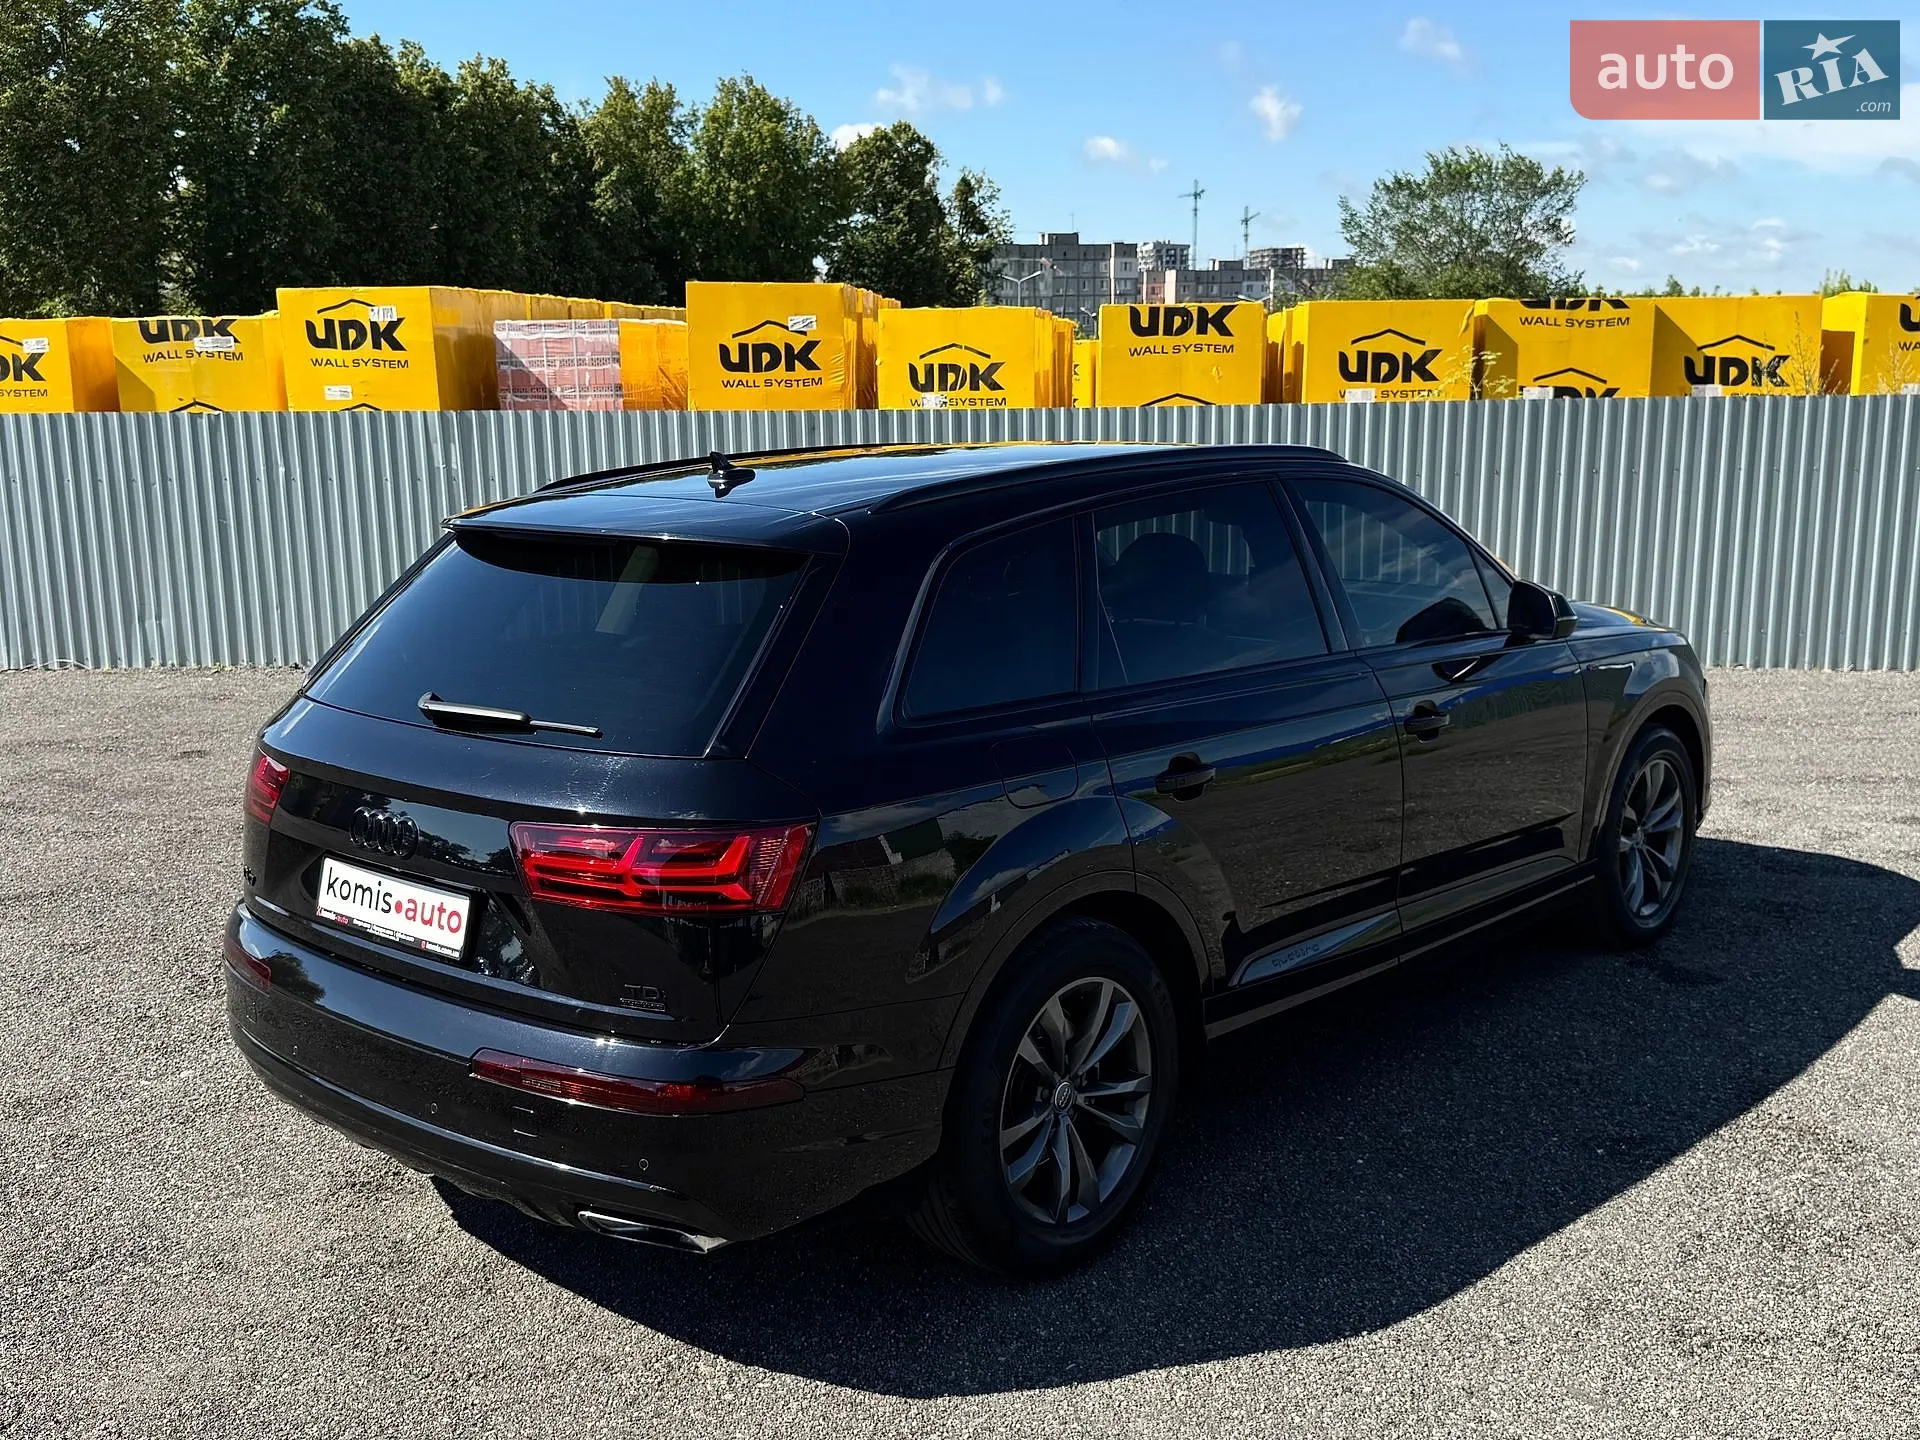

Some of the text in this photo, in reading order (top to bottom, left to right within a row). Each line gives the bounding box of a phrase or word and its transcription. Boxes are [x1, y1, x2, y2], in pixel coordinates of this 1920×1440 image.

[1129, 304, 1239, 337] UDK
[1519, 316, 1630, 329] WALL SYSTEM
[139, 318, 242, 344] UDK
[305, 317, 408, 352] UDK
[143, 349, 183, 363] WALL
[719, 339, 822, 373] UDK
[1128, 343, 1235, 357] WALL SYSTEM
[1898, 341, 1920, 352] WA
[310, 358, 409, 369] WALL SYSTEM
[1338, 349, 1443, 383] UDK
[1683, 355, 1792, 387] UDK
[721, 377, 823, 389] WALL SYSTEM
[908, 361, 1006, 392] UDK
[948, 397, 1007, 408] SYSTEM
